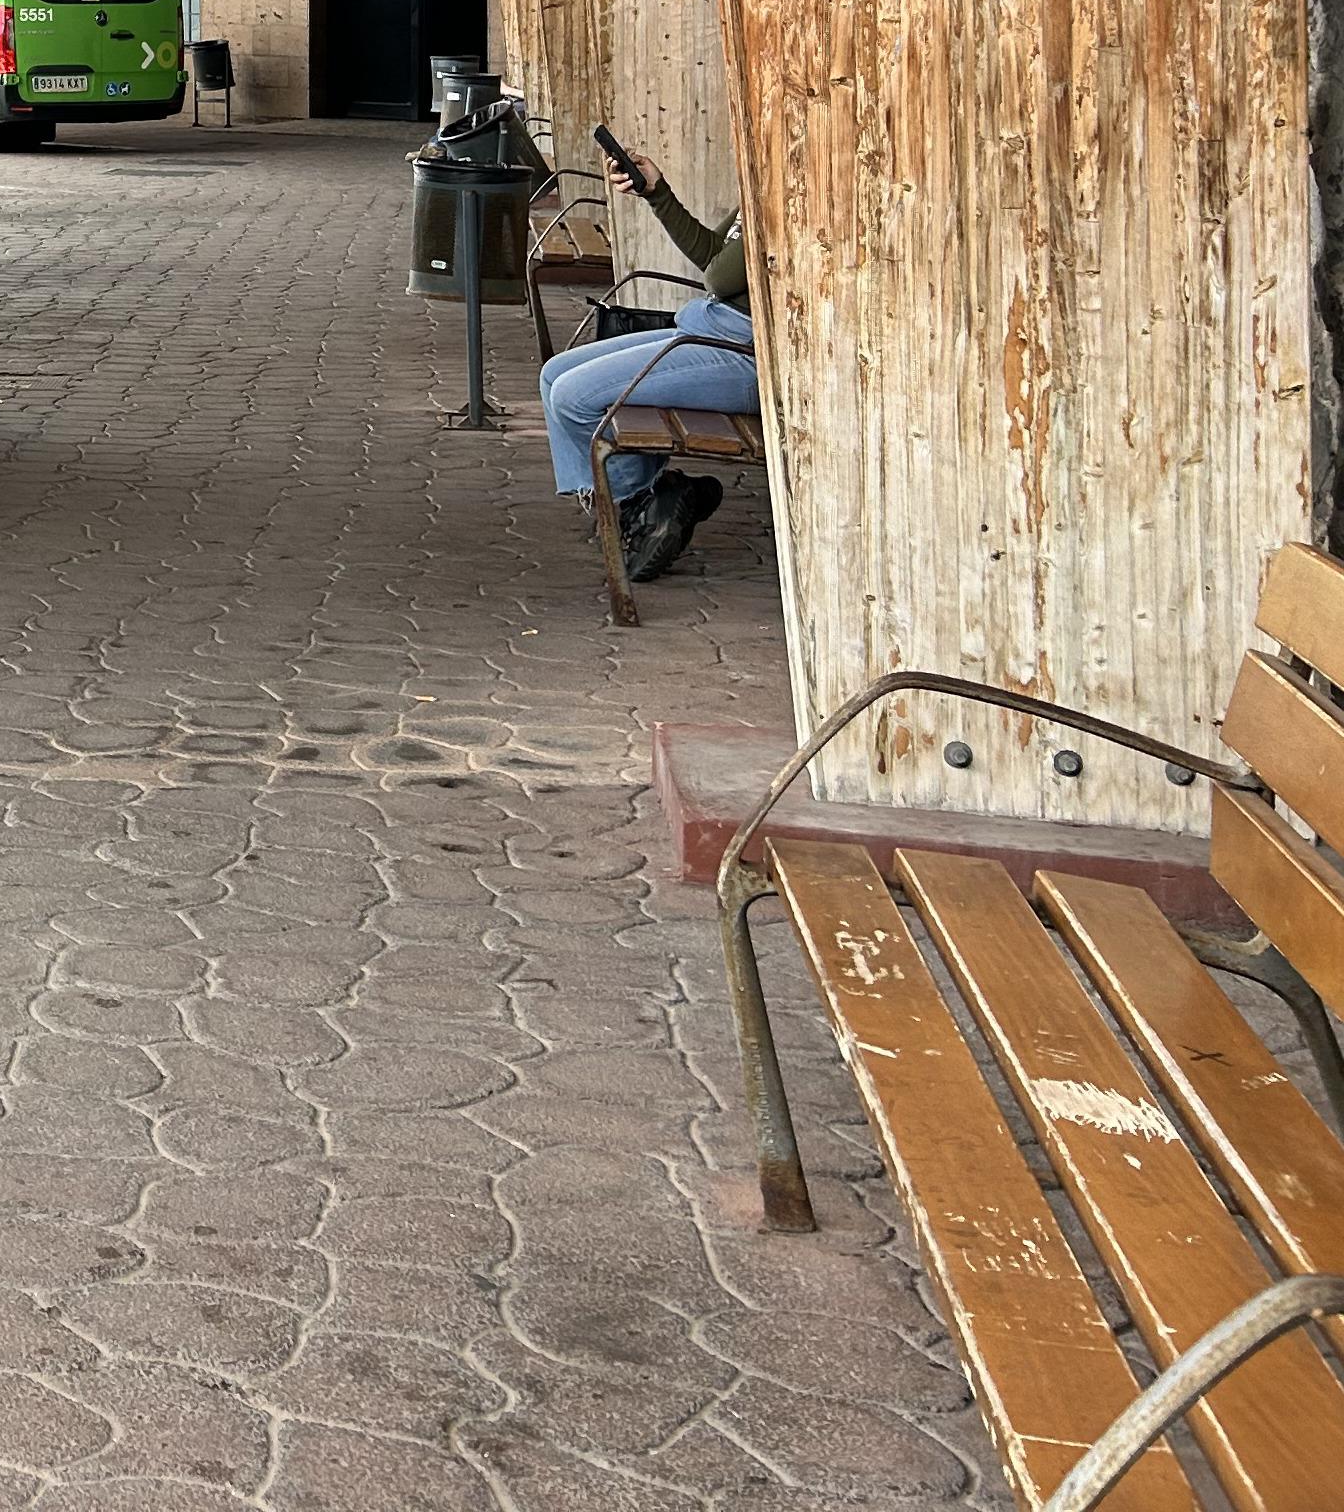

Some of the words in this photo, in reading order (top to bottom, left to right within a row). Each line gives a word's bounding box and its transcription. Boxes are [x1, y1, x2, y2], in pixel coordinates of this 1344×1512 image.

[19, 7, 54, 22] 5551
[39, 78, 65, 89] 9314
[66, 77, 86, 89] KXT
